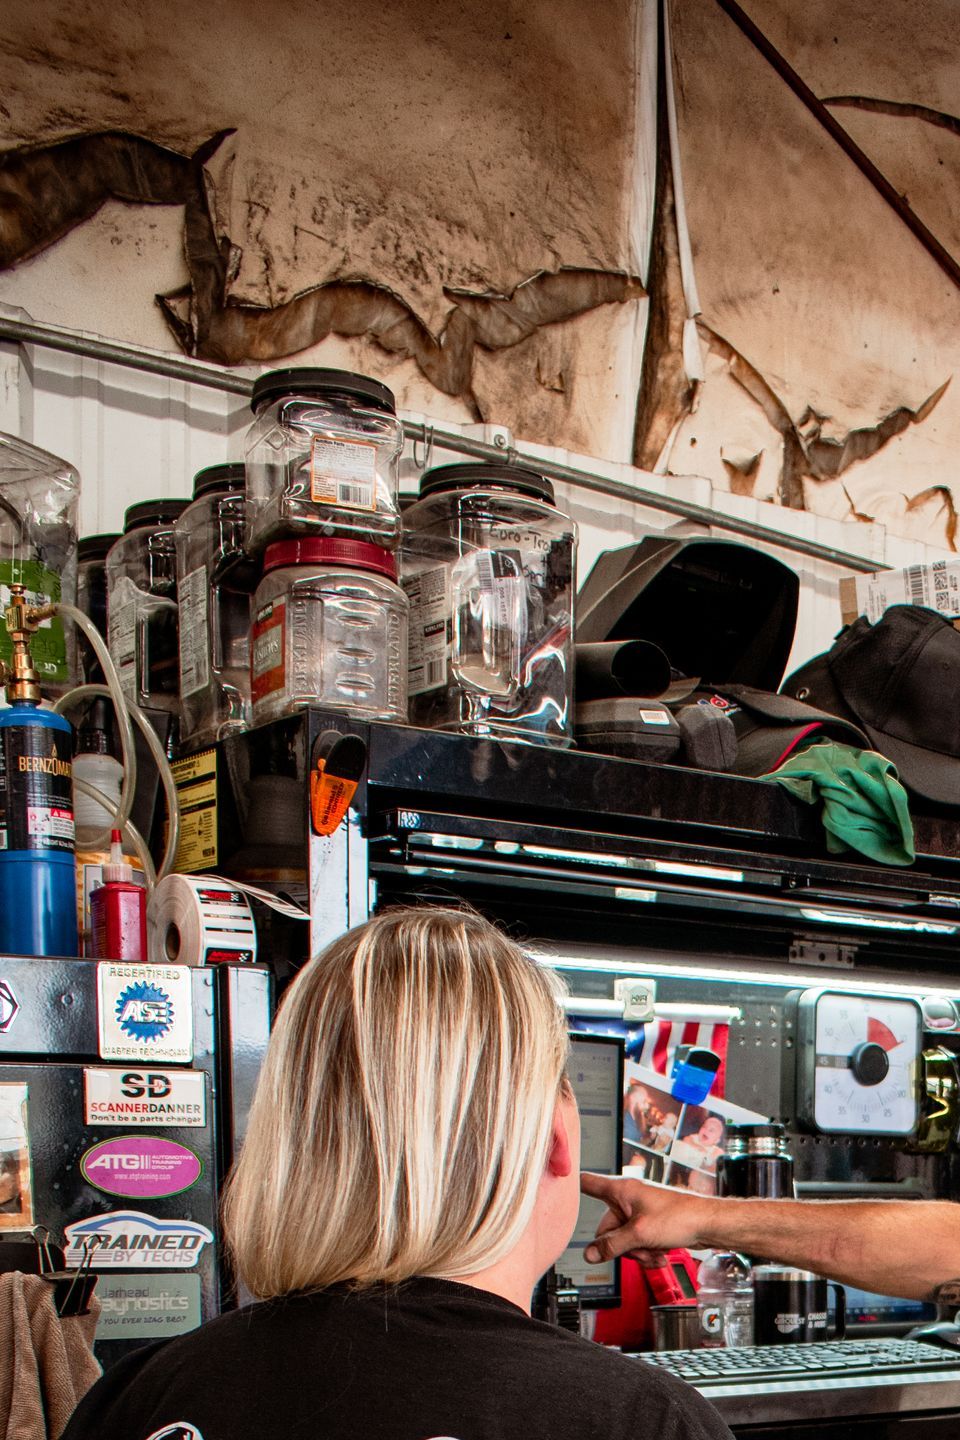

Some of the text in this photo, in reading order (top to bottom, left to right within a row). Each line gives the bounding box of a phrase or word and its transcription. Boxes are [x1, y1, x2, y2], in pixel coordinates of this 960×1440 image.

[120, 1000, 168, 1024] ASE
[120, 1073, 172, 1098] SD
[90, 1102, 201, 1114] SCANNERDANNER
[91, 1114, 116, 1122] Don't
[118, 1114, 129, 1122] be
[140, 1116, 163, 1124] parts
[166, 1115, 201, 1124] changer
[87, 1154, 140, 1170] ATG
[114, 1173, 171, 1181] www.atgtraining.com
[71, 1234, 201, 1250] TRAINED
[113, 1250, 194, 1262] BY TECHS
[102, 1287, 150, 1298] Jarhead
[99, 1291, 189, 1316] agnostics
[144, 1316, 164, 1324] DIAG
